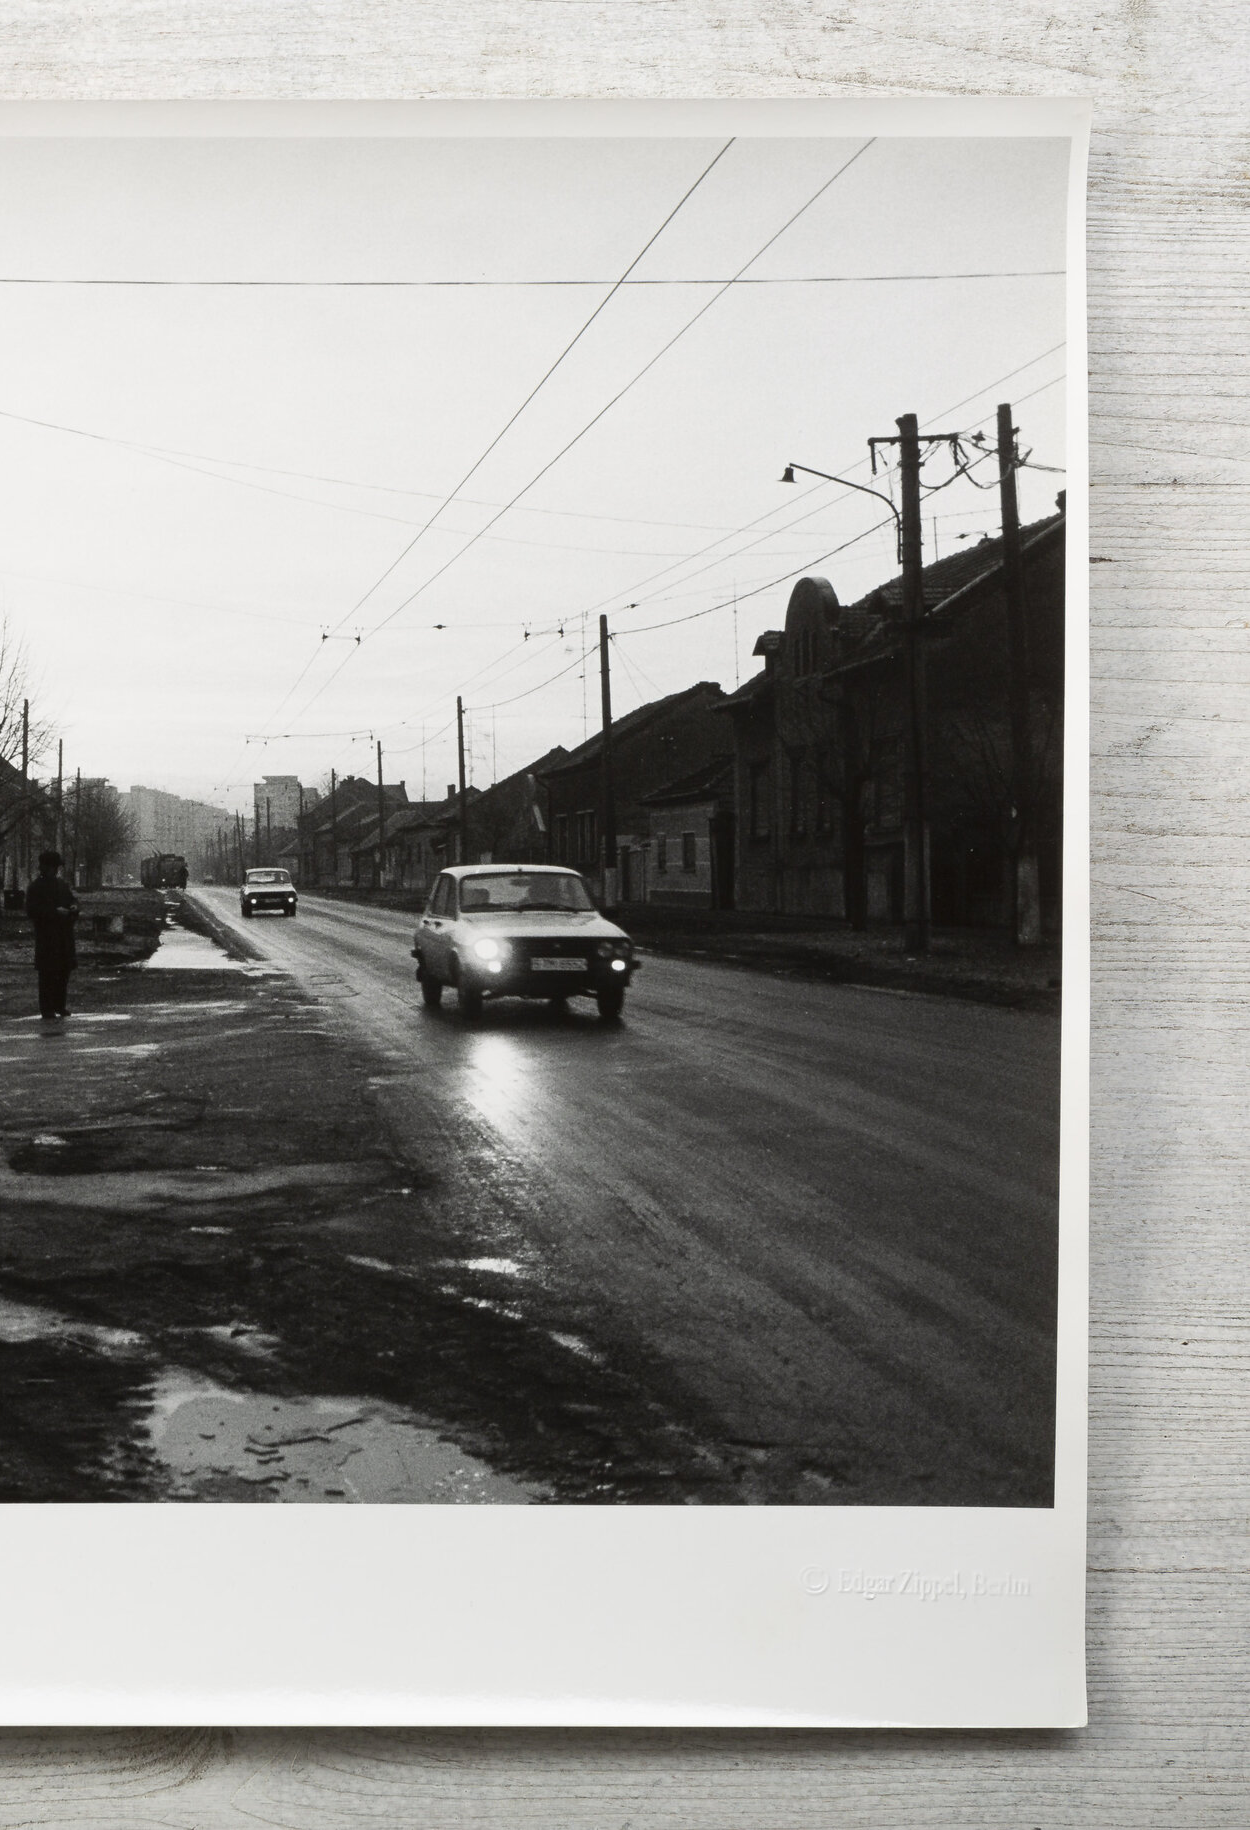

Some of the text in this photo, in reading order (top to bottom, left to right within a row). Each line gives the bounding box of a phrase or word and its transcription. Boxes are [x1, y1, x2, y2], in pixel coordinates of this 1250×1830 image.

[837, 1568, 895, 1600] Edgar
[898, 1568, 967, 1601] Zippel,
[972, 1568, 1031, 1597] Berlin
